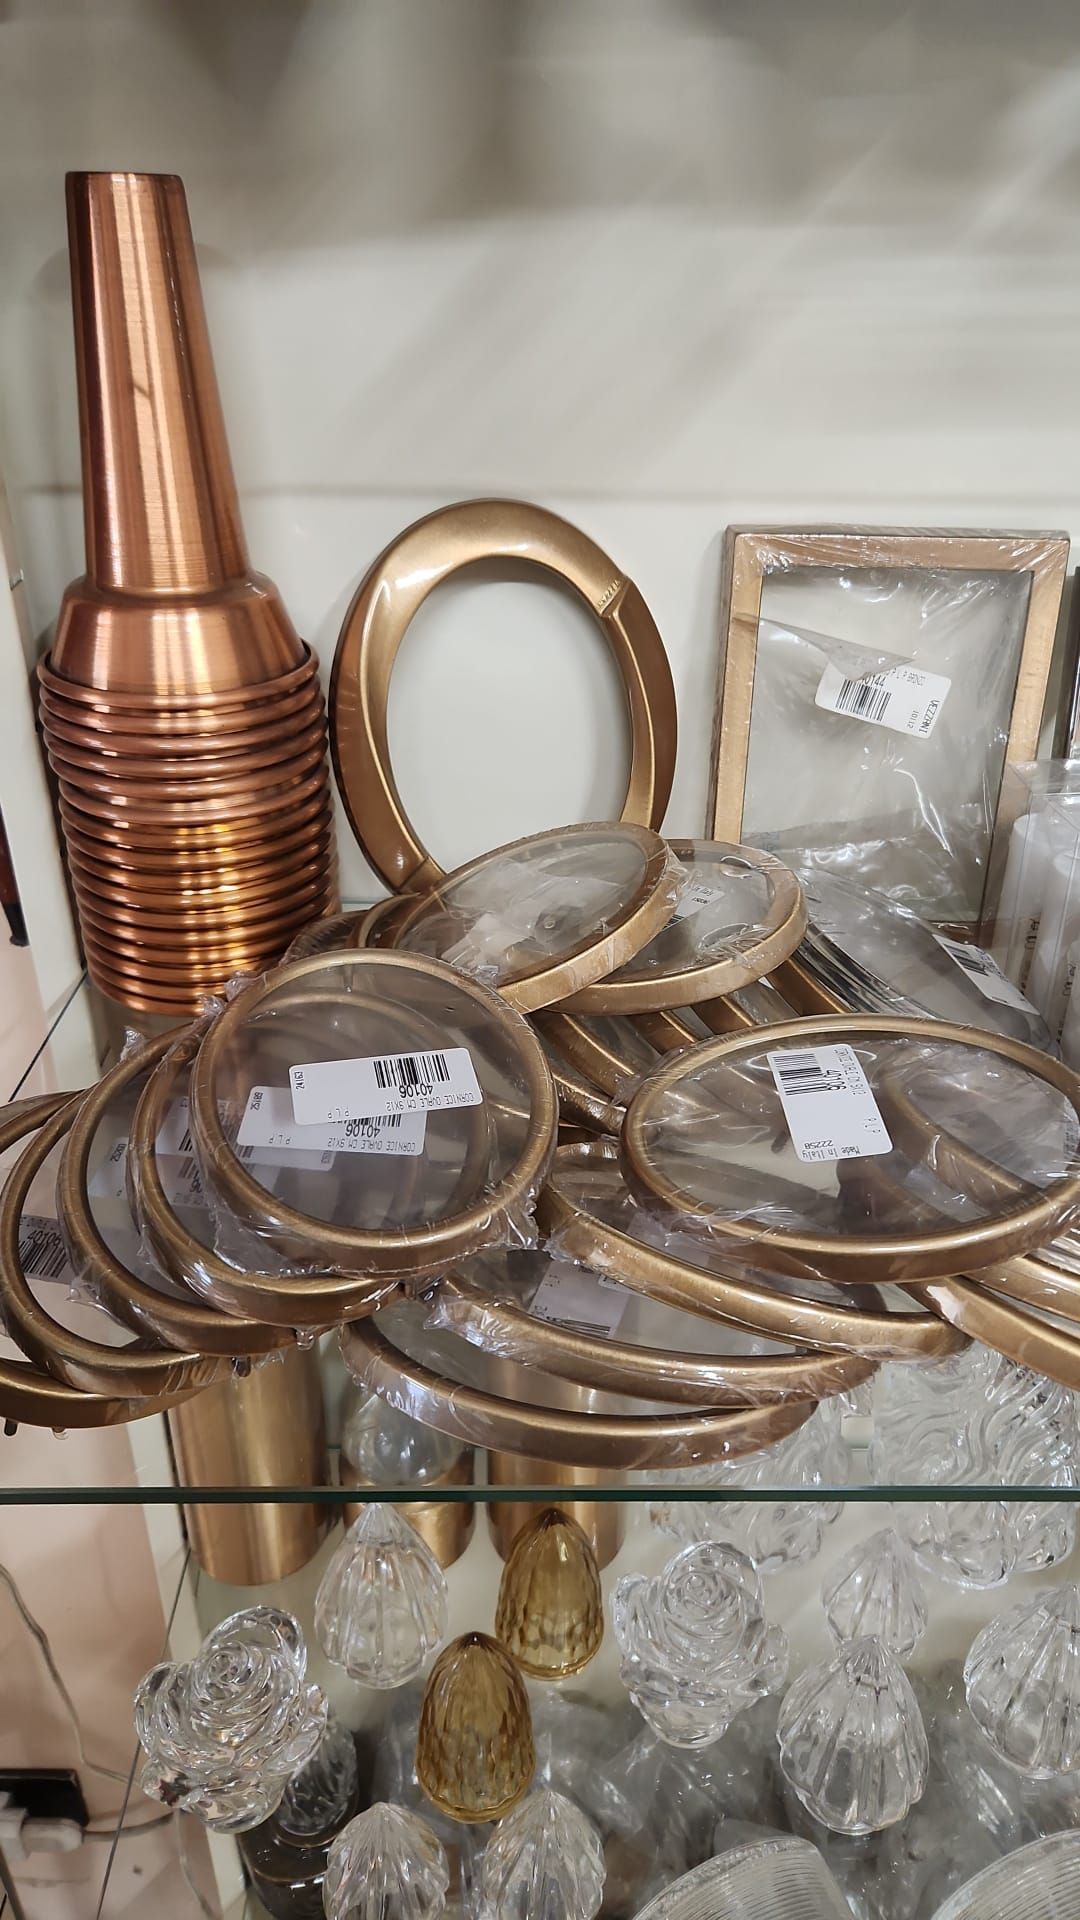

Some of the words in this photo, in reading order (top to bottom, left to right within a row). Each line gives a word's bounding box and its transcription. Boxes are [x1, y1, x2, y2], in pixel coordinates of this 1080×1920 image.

[919, 700, 940, 733] VEZZANI
[399, 1083, 434, 1098] 40106
[406, 1099, 417, 1109] CM
[420, 1097, 441, 1108] OVALE
[446, 1092, 475, 1104] CORNICE
[345, 1123, 381, 1138] 40106
[347, 1139, 358, 1149] CM
[361, 1139, 383, 1150] OVALE
[386, 1140, 416, 1153] CORNICE
[802, 1149, 825, 1161] Italy
[840, 1145, 861, 1156] Made
